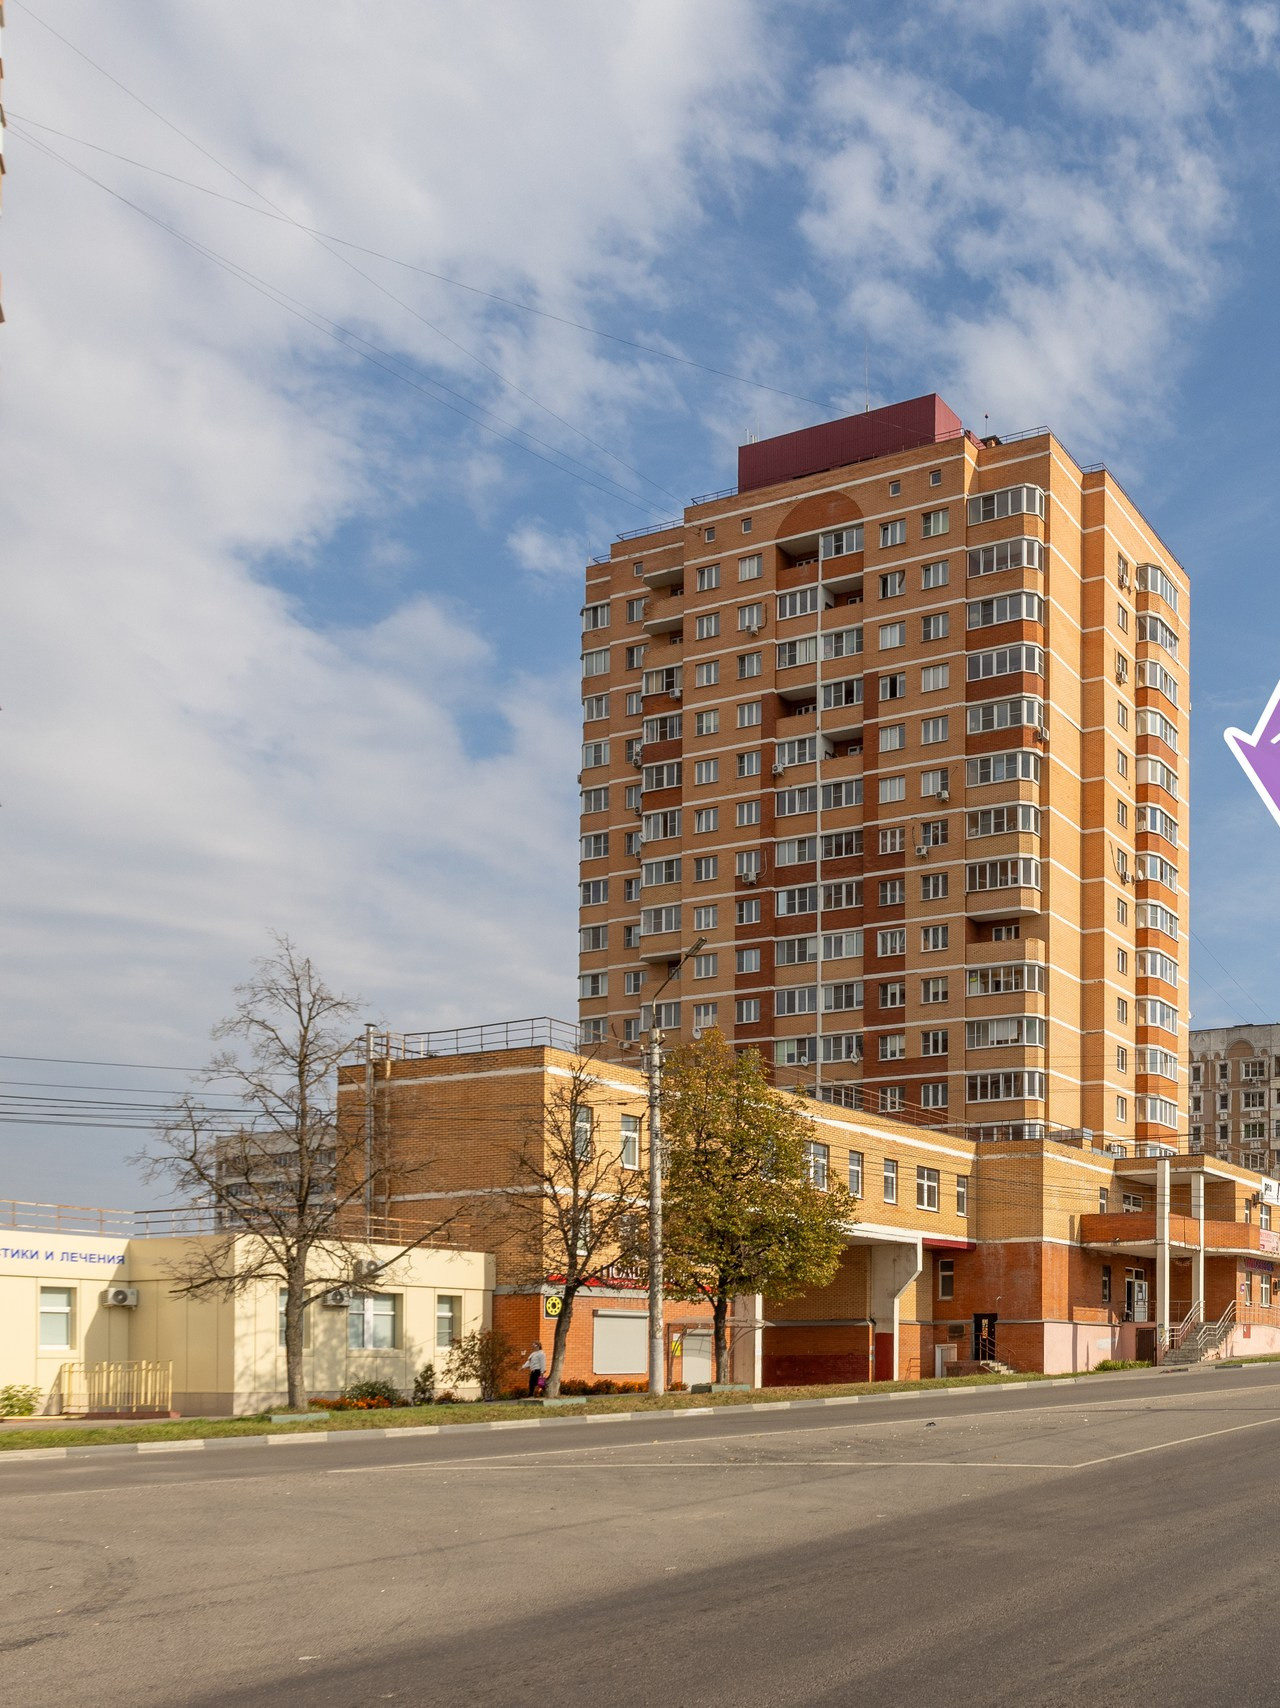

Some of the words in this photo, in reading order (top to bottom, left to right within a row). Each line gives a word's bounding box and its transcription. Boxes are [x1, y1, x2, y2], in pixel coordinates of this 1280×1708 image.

[0, 1248, 39, 1260] ТИКИ
[45, 1251, 54, 1260] И
[60, 1252, 125, 1265] ЛЕЧЕНИЯ
